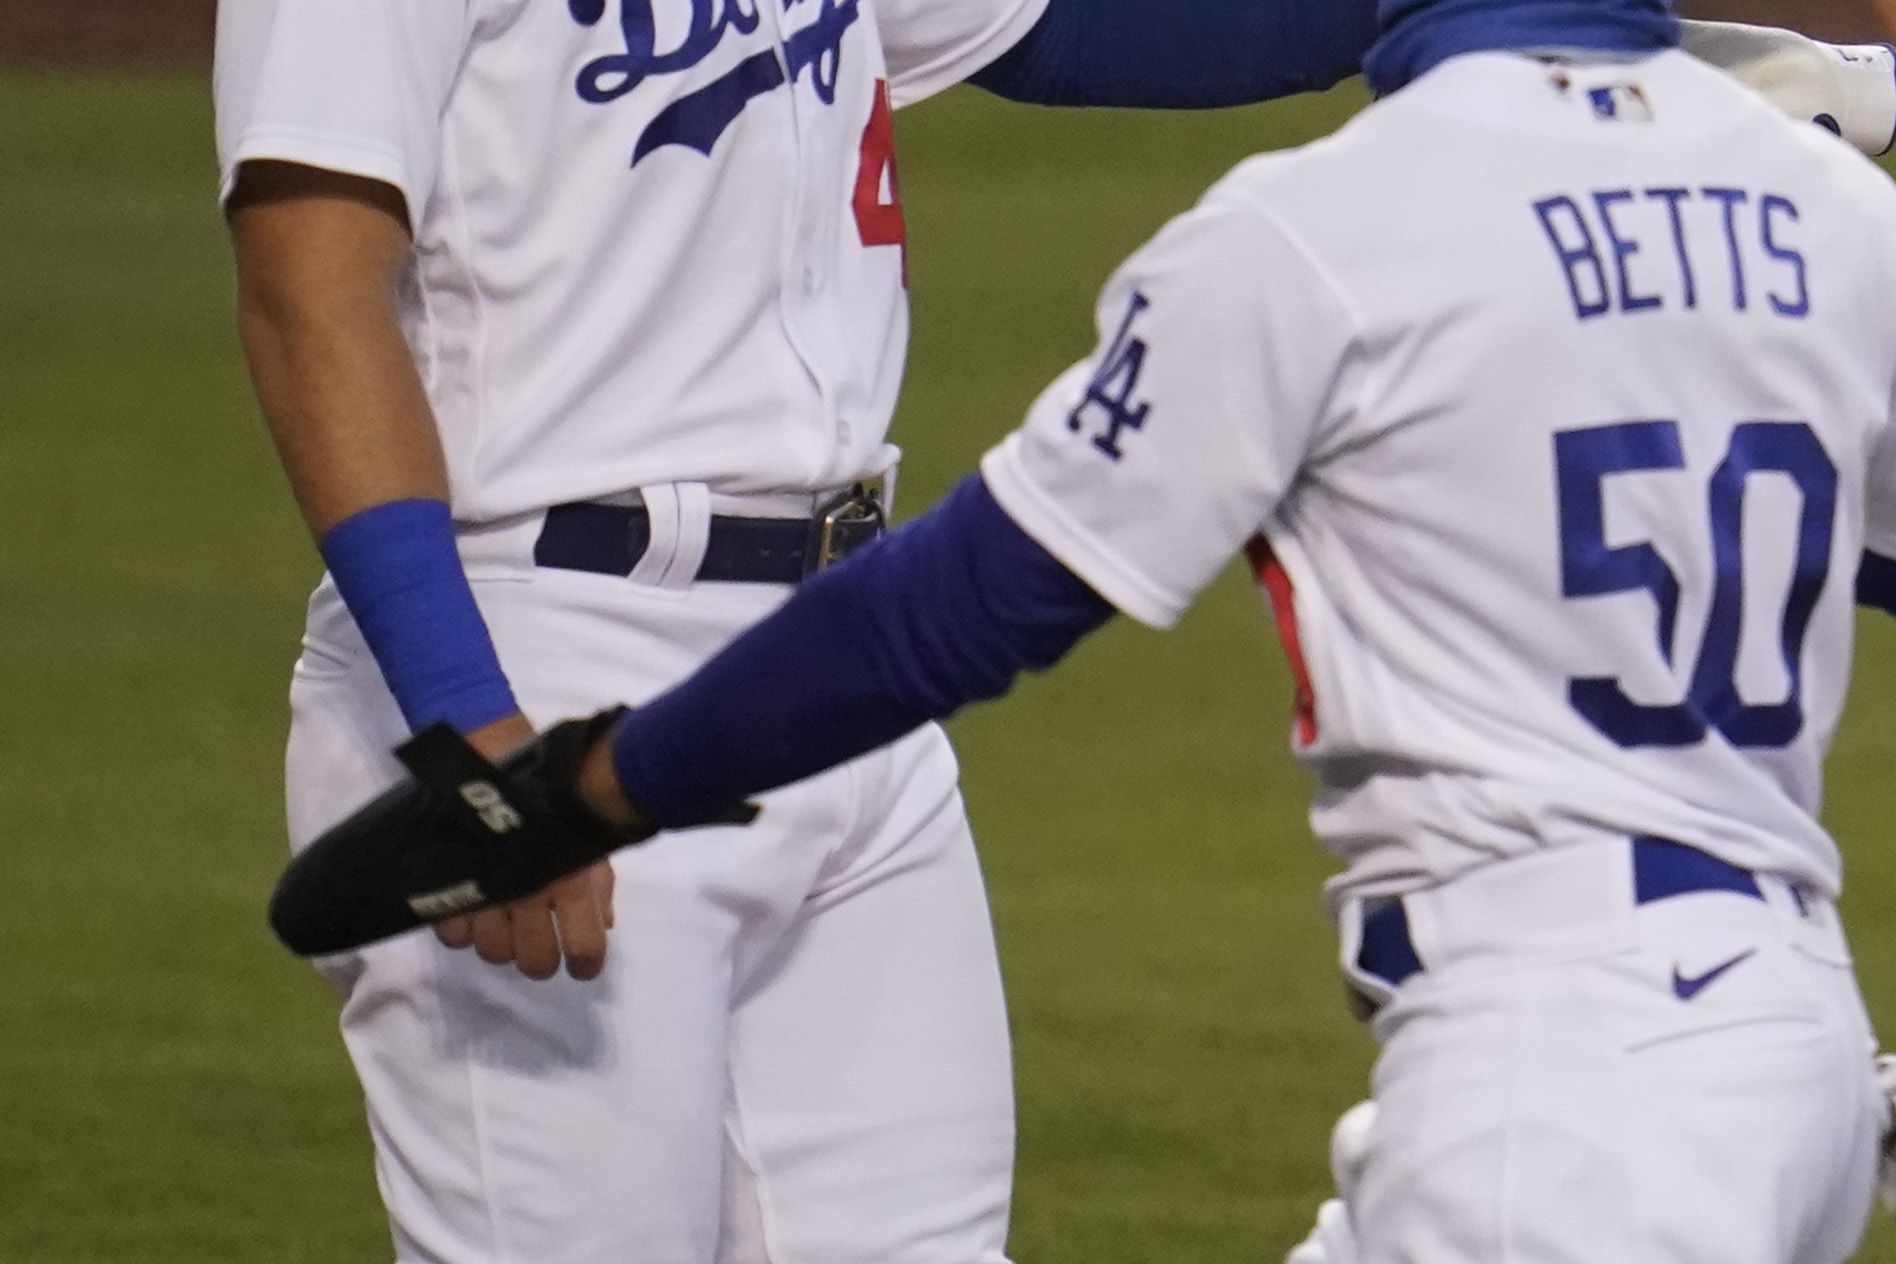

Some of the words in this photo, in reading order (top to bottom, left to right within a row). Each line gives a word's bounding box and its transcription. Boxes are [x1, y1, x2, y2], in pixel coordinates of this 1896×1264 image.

[1532, 188, 1808, 320] BETTS
[1068, 292, 1150, 461] LA
[1552, 420, 1838, 749] 50
